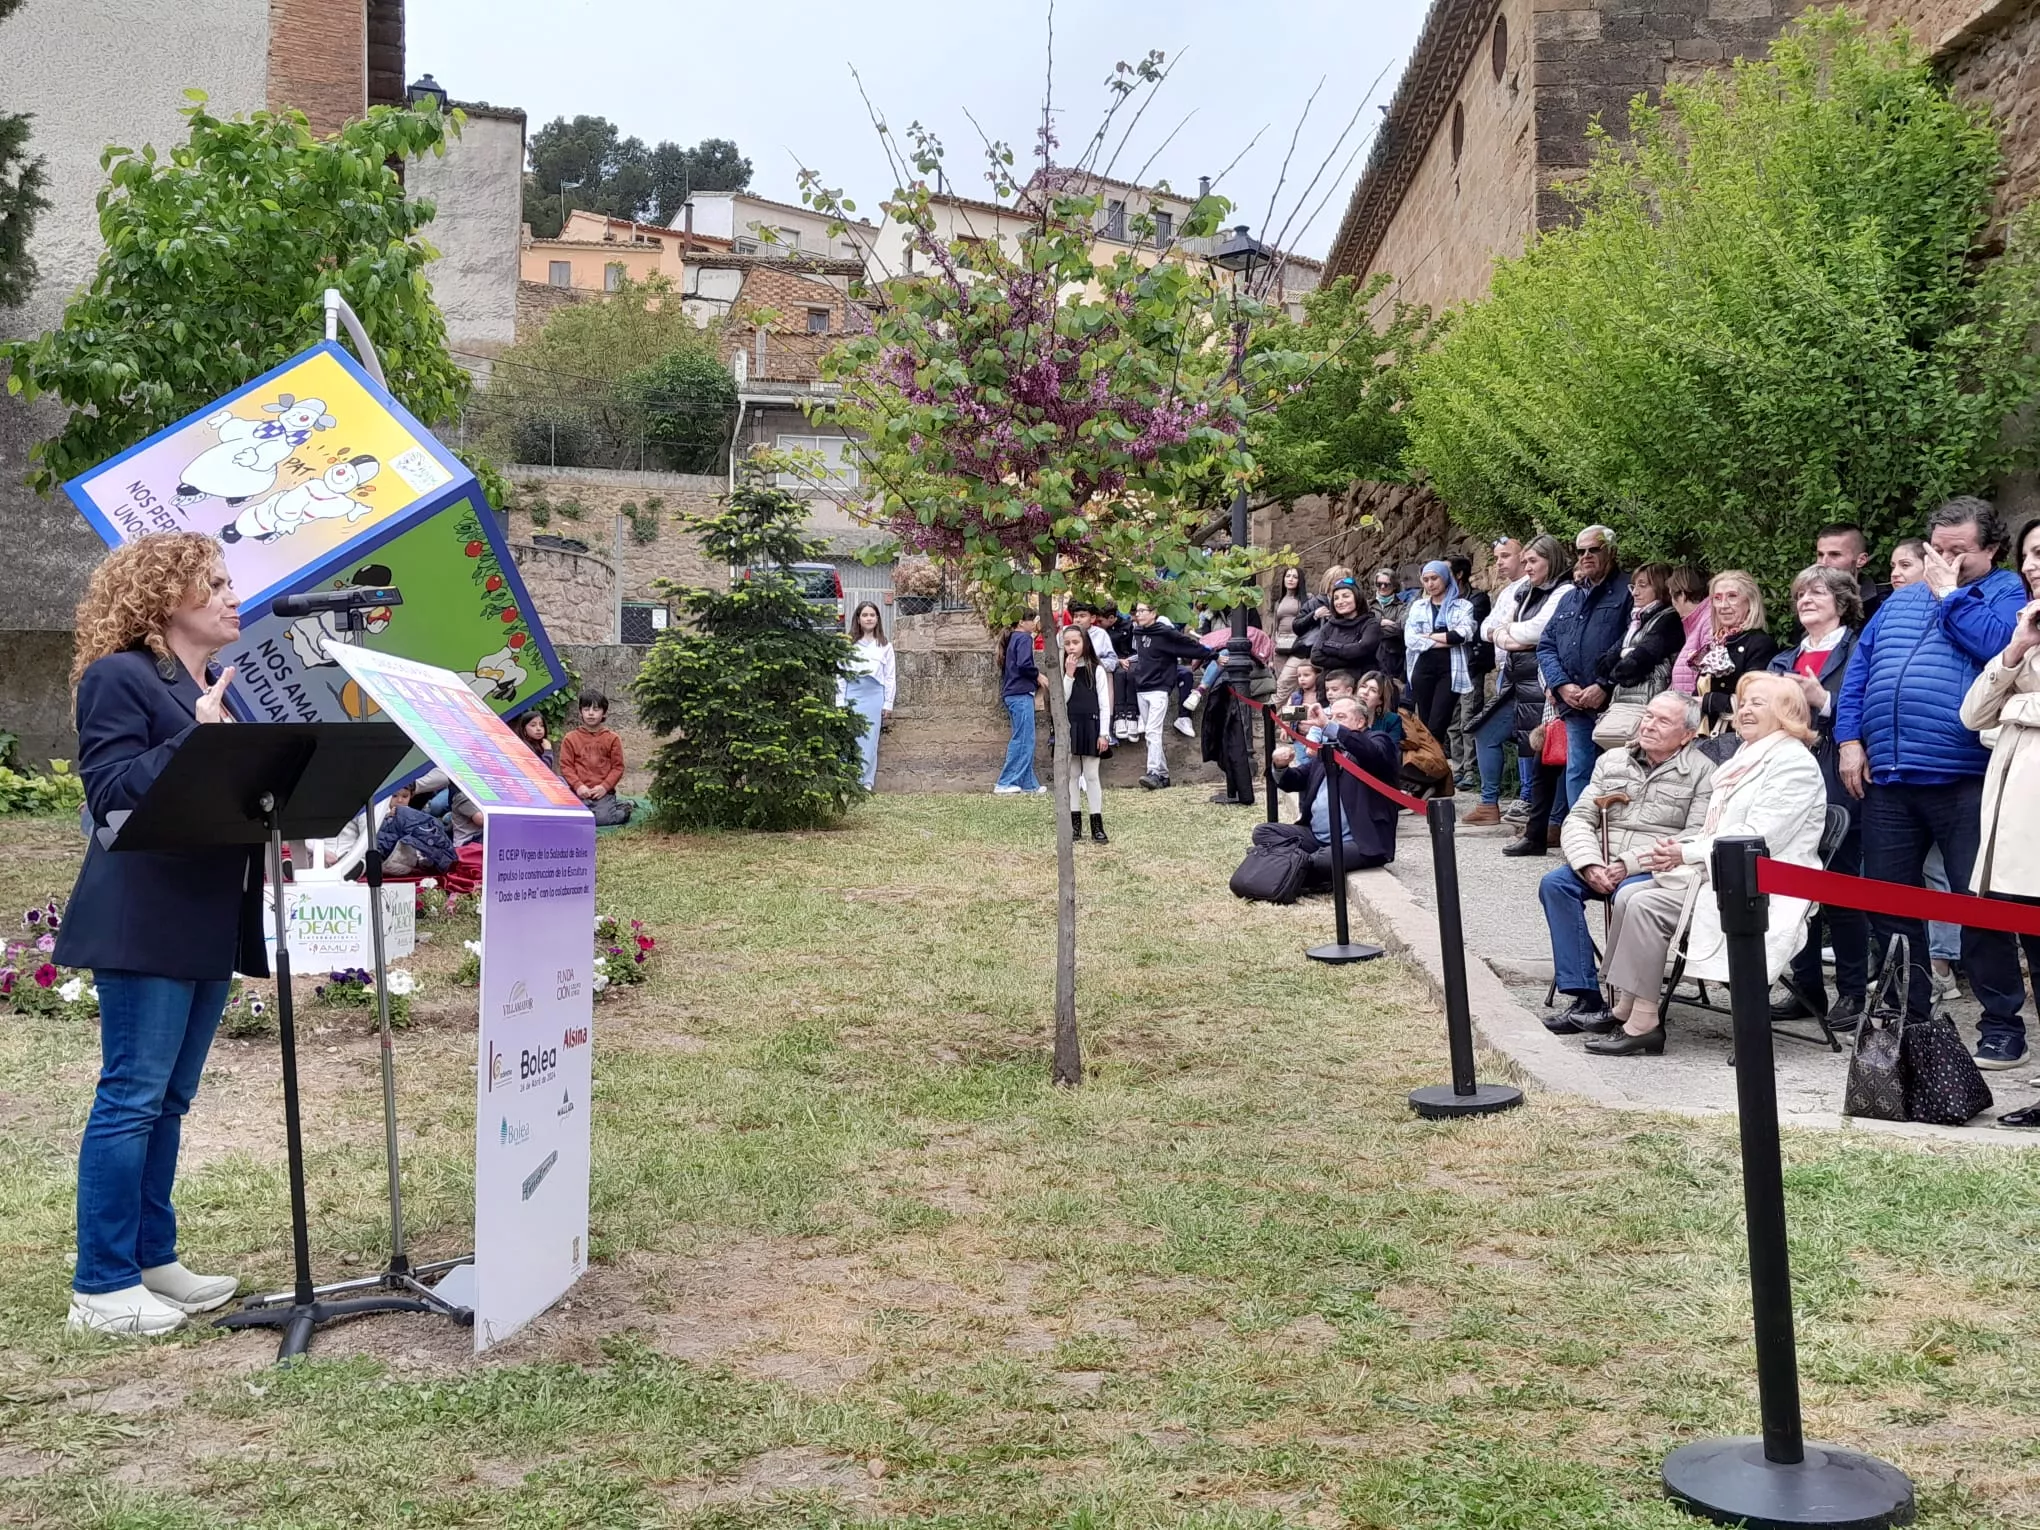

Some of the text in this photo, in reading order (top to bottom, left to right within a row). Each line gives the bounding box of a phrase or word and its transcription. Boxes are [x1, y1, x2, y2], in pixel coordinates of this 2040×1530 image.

[282, 457, 316, 476] PAT
[126, 480, 157, 508] NOS
[256, 638, 323, 723] NOS AMA
[498, 849, 505, 861] El
[506, 848, 519, 861] CEIP
[521, 848, 537, 862] Virgen
[537, 848, 544, 860] de
[544, 848, 549, 859] la
[550, 847, 568, 859] Soledad
[568, 847, 575, 859] de
[519, 869, 525, 881] la
[555, 866, 561, 878] de
[561, 866, 567, 877] la
[514, 889, 520, 901] de
[521, 889, 527, 900] la
[540, 888, 549, 898] con
[549, 887, 554, 898] la
[298, 904, 362, 925] LIVING
[298, 920, 358, 940] PEACE
[563, 1025, 588, 1051] Alsina
[520, 1044, 557, 1080] Bolea
[508, 1119, 530, 1144] Bolea
